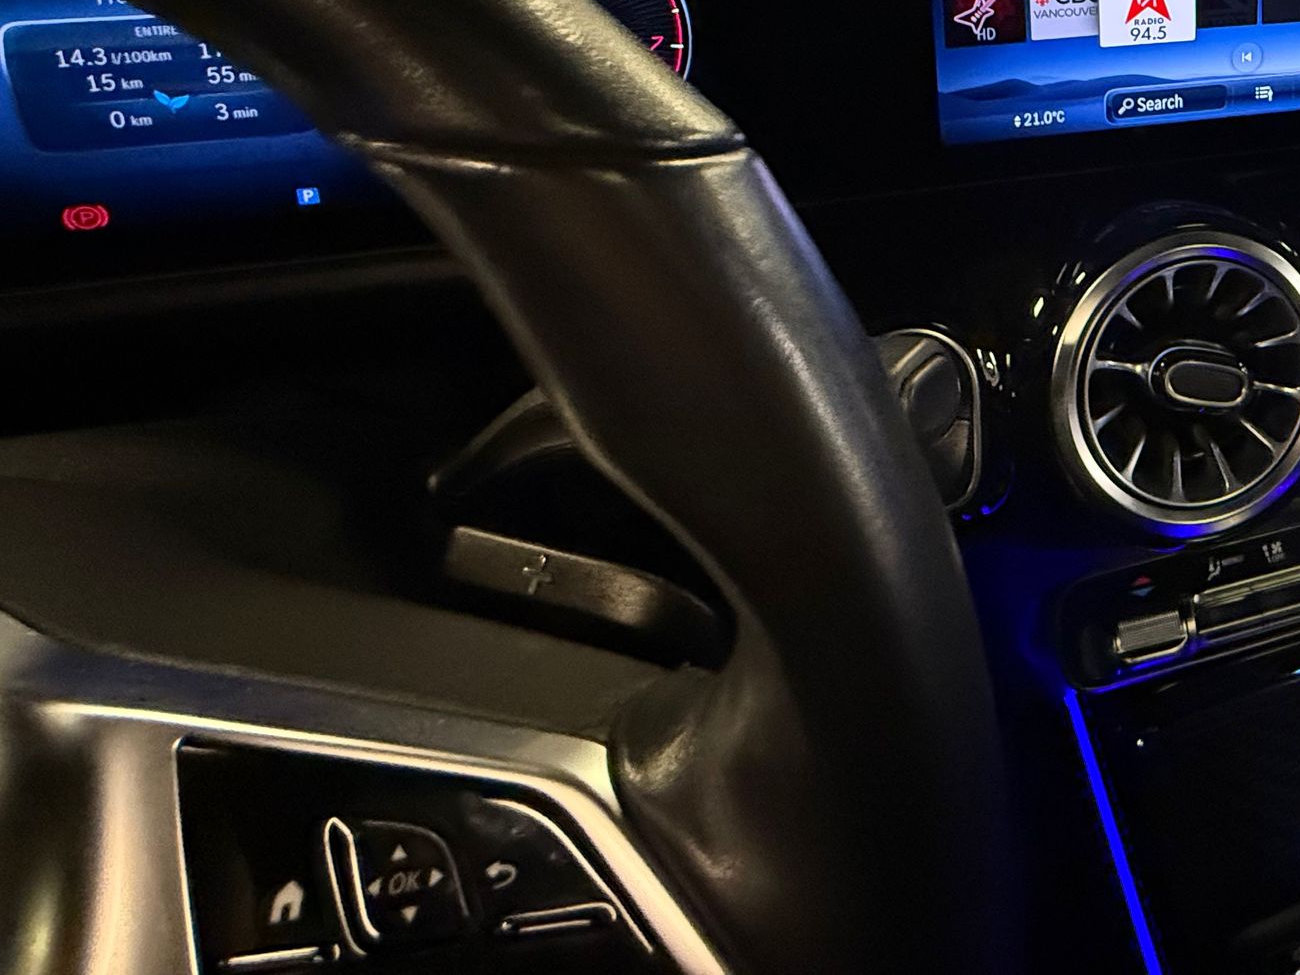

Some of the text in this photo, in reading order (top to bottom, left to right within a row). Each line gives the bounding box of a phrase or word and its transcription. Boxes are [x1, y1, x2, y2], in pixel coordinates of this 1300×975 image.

[1033, 6, 1098, 20] VANCOUVE
[1134, 17, 1165, 26] RADIO
[650, 36, 664, 50] 7
[977, 27, 996, 41] HD
[1130, 26, 1167, 42] 94.5
[55, 47, 108, 68] 14.3
[86, 73, 144, 93] 15 km
[206, 65, 235, 84] 55
[214, 102, 259, 121] 3 min
[1137, 93, 1184, 113] Search
[109, 110, 153, 129] 0 km
[1023, 110, 1066, 127] 21.0°C
[388, 871, 420, 894] OK
